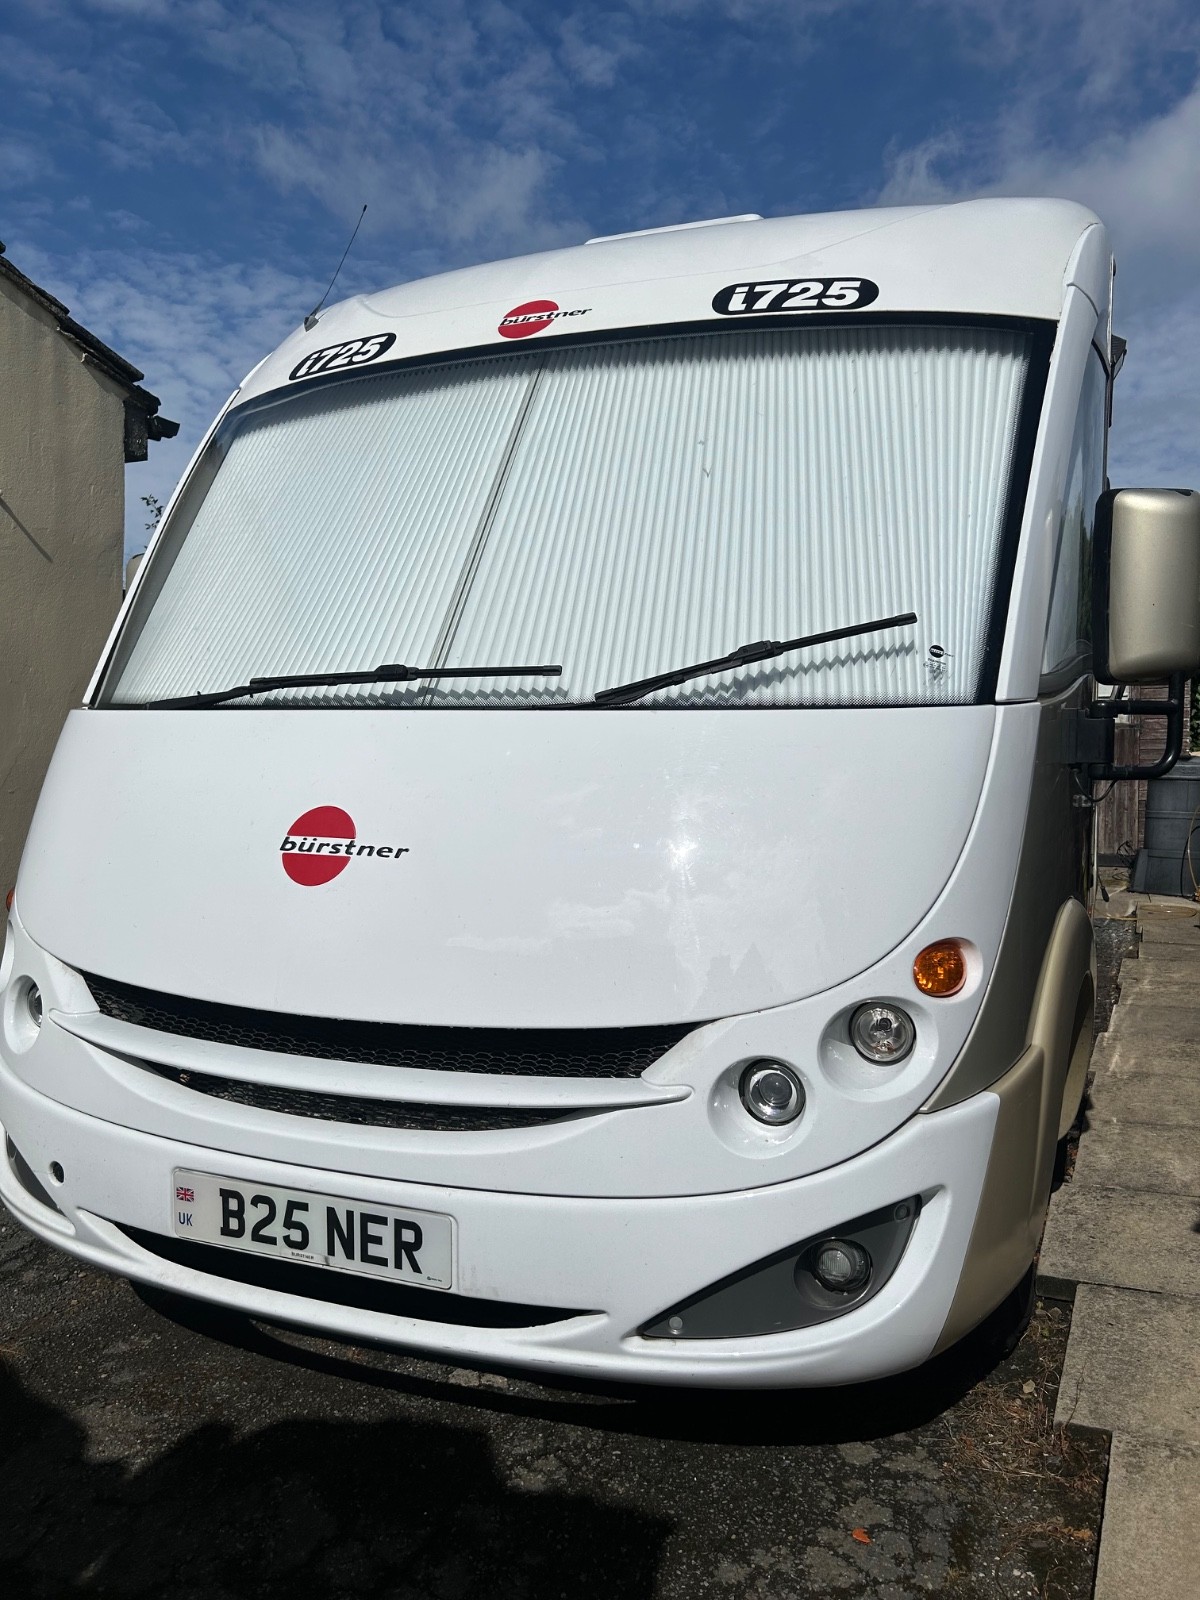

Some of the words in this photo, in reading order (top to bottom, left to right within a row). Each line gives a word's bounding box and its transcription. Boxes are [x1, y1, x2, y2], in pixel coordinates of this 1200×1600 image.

[728, 280, 862, 312] i725
[295, 335, 389, 377] i725
[279, 836, 410, 859] bürstner
[178, 1212, 193, 1226] UK
[219, 1187, 310, 1251] B25
[326, 1206, 423, 1275] NER
